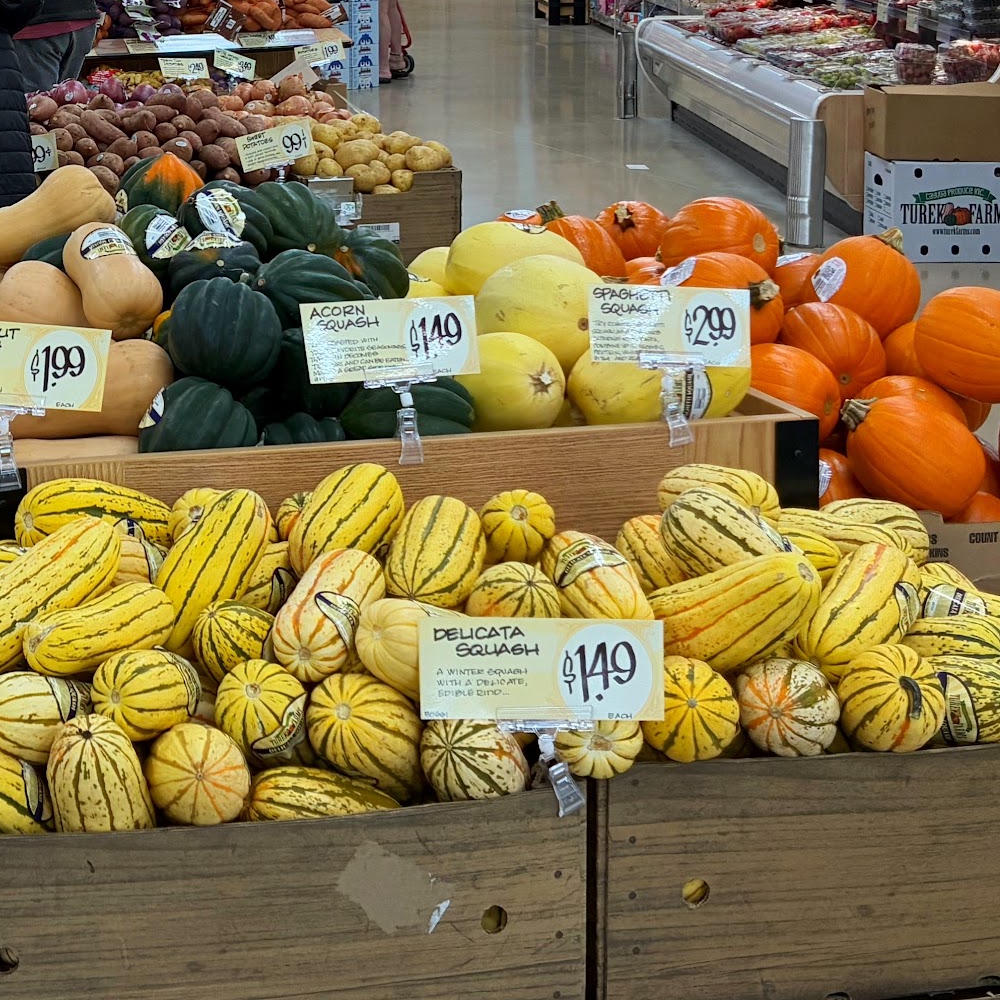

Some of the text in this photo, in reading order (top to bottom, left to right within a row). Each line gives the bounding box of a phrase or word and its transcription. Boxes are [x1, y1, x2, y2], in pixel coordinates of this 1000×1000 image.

[242, 137, 274, 150] POTATOES
[246, 131, 267, 143] SWEET
[900, 203, 946, 224] TUREK
[310, 305, 366, 320] ACORN
[317, 316, 380, 332] SQUASH
[684, 304, 737, 347] $2.99
[30, 344, 86, 393] $1.99
[969, 532, 999, 544] COUNT
[433, 626, 525, 642] DELICATA
[455, 642, 540, 657] SQUASH
[446, 668, 485, 676] WINTER
[487, 668, 528, 676] SQUASH
[562, 641, 637, 703] $1.49
[476, 678, 528, 687] DELICATE,
[437, 689, 474, 697] EDIBLE
